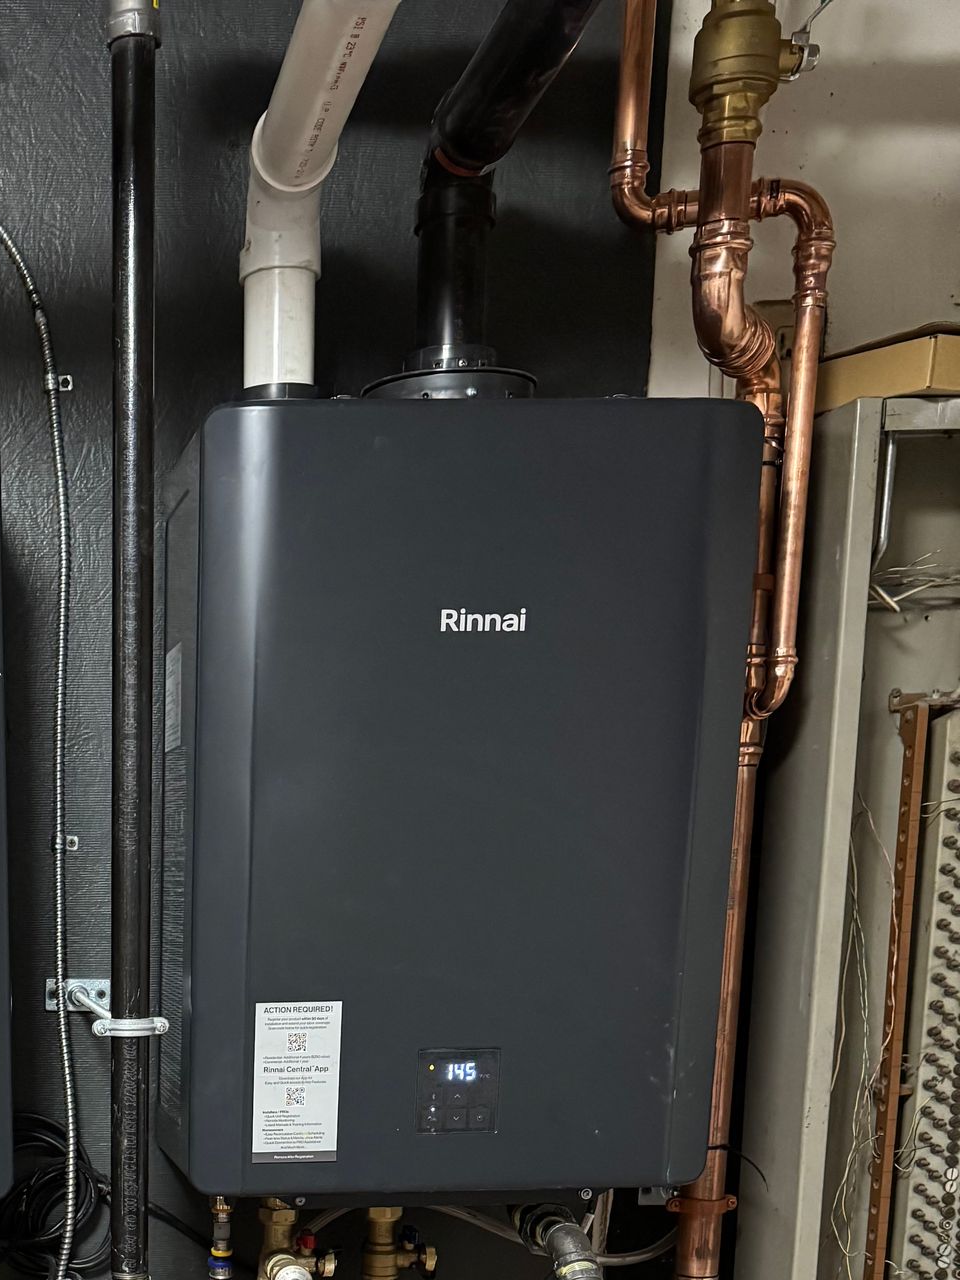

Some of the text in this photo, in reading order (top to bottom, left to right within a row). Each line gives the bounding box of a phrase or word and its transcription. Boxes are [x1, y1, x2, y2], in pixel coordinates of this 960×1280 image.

[440, 608, 526, 632] Rinnai
[264, 1006, 292, 1014] ACTION
[448, 1063, 476, 1080] 145
